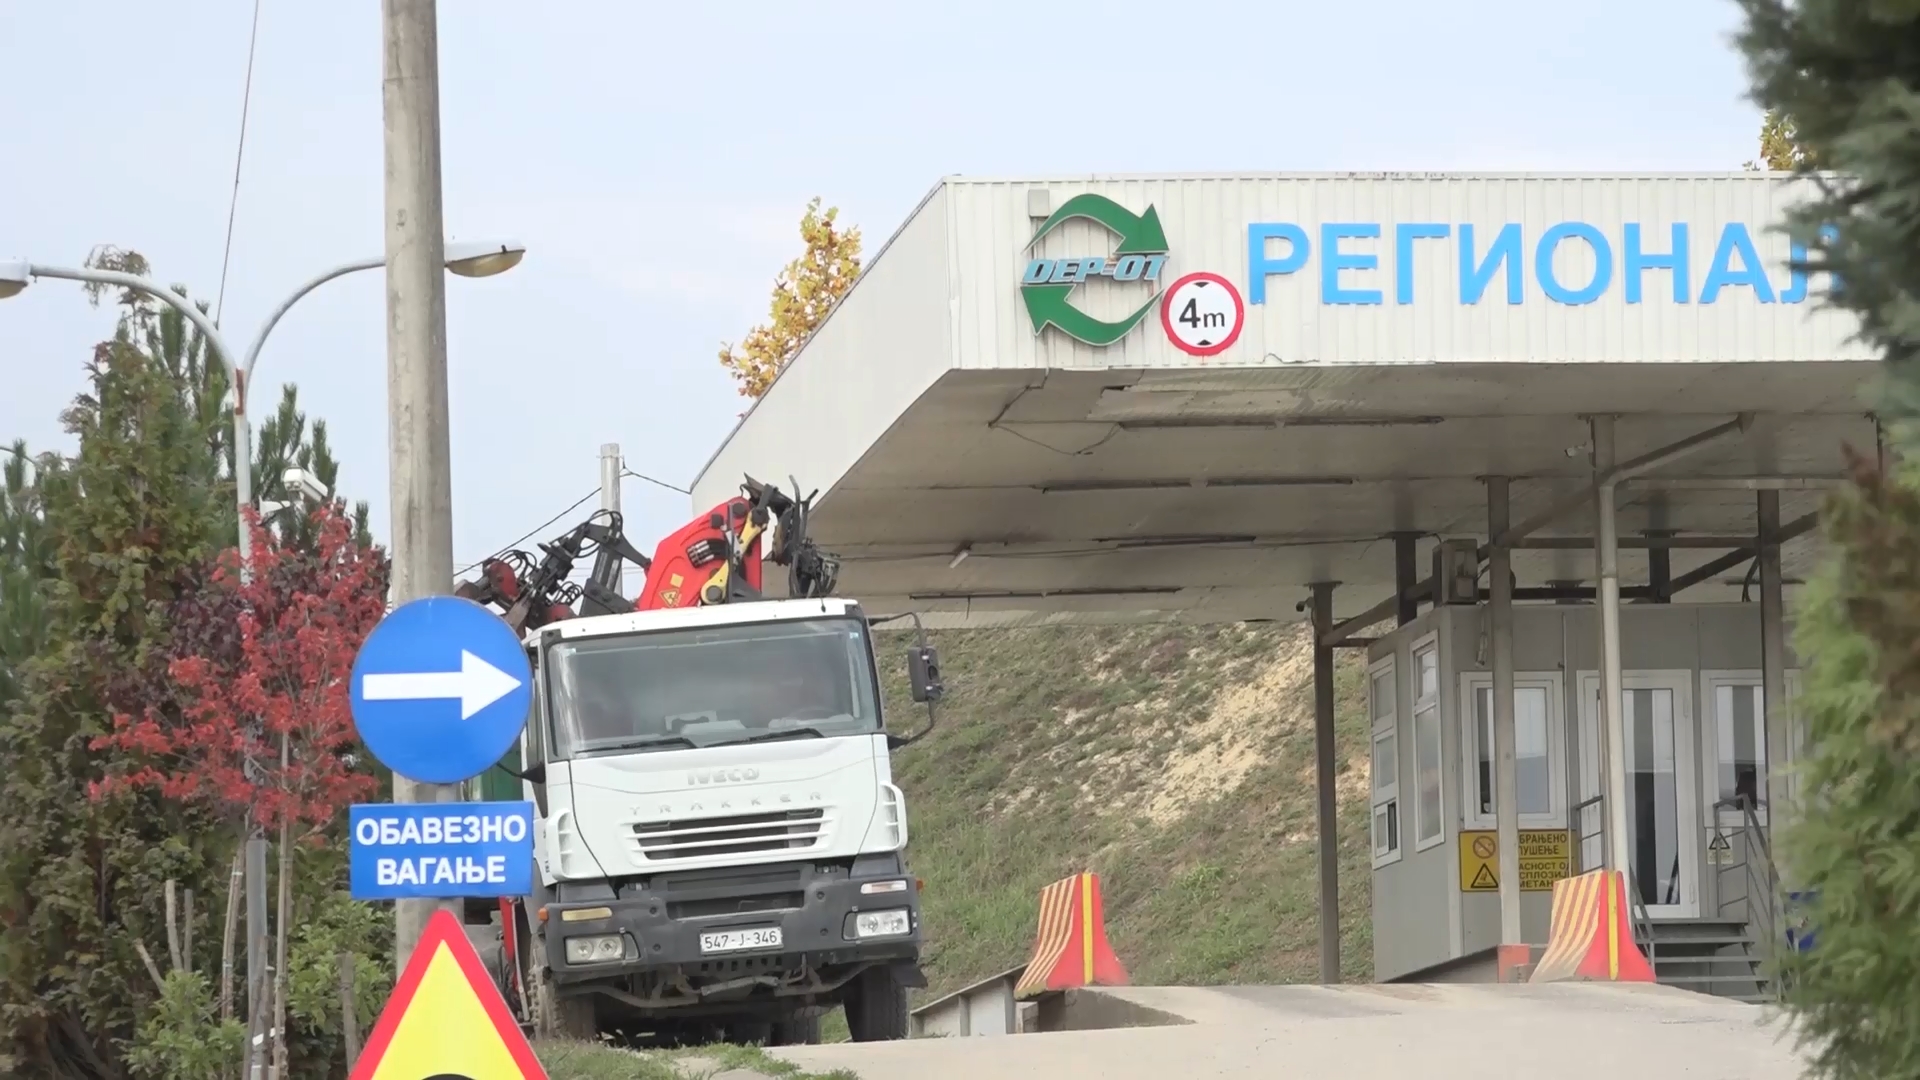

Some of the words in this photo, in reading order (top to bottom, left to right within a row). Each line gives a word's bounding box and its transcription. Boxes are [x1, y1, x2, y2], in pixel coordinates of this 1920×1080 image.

[688, 768, 760, 786] IVECO
[629, 791, 822, 816] TRAKKER
[356, 815, 527, 846] ОБАВЕЗНО
[1519, 833, 1568, 844] БРАЊЕНО
[377, 856, 506, 886] ВАГАЊЕ
[1519, 862, 1556, 871] АСНОСТ
[1519, 870, 1573, 880] СПЛОЗИЈ
[1519, 879, 1554, 888] ЕТАН
[704, 930, 778, 949] 547-J-346
